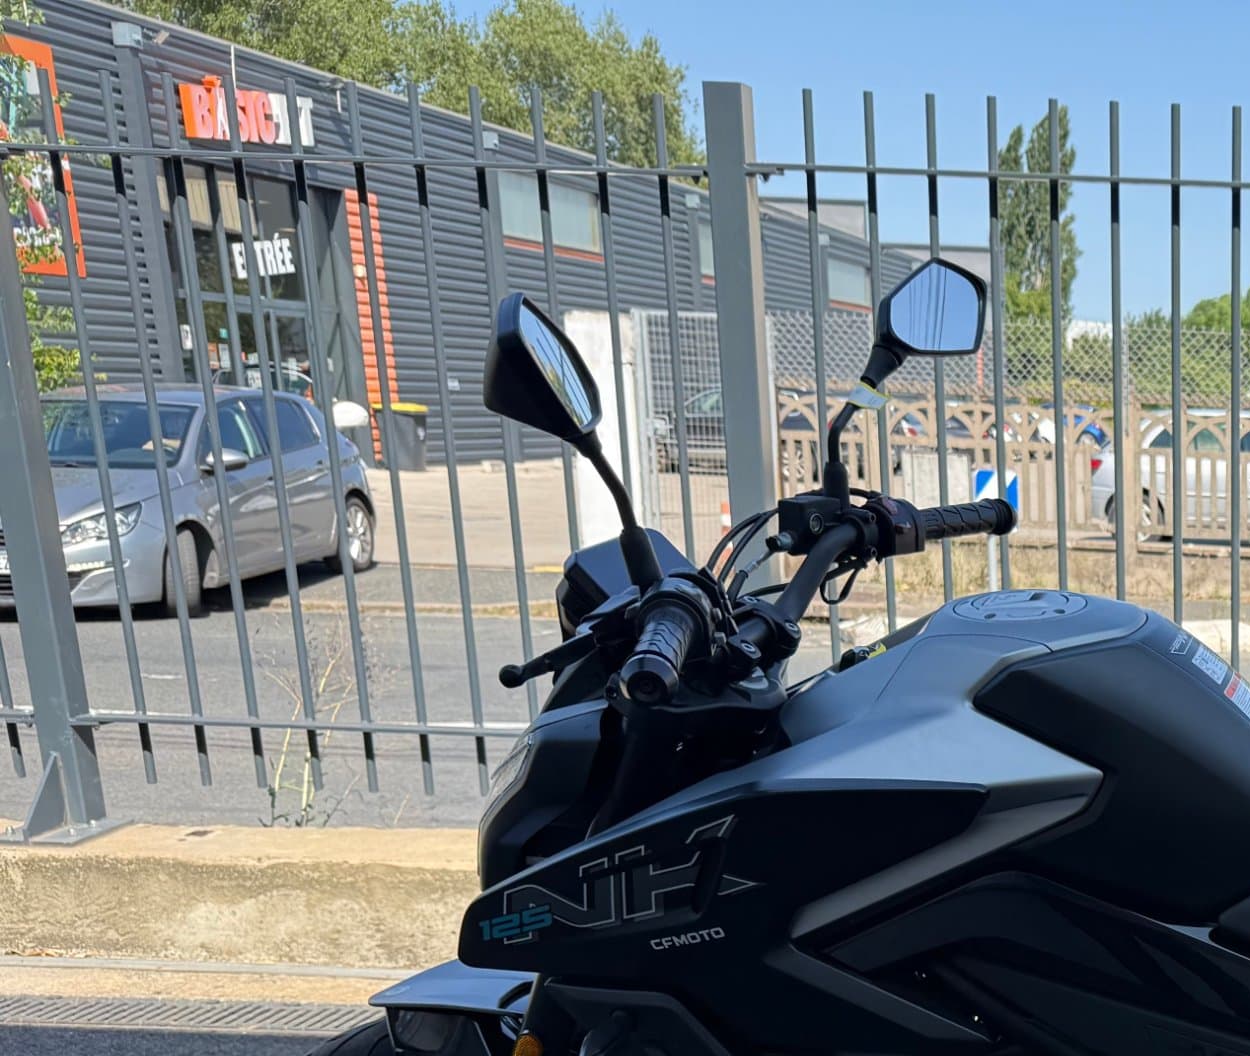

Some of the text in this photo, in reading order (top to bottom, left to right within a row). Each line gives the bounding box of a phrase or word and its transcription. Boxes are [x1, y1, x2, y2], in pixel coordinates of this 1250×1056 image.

[231, 233, 296, 279] ETRÉE
[479, 904, 553, 941] 125
[650, 927, 726, 951] CFMOTO
